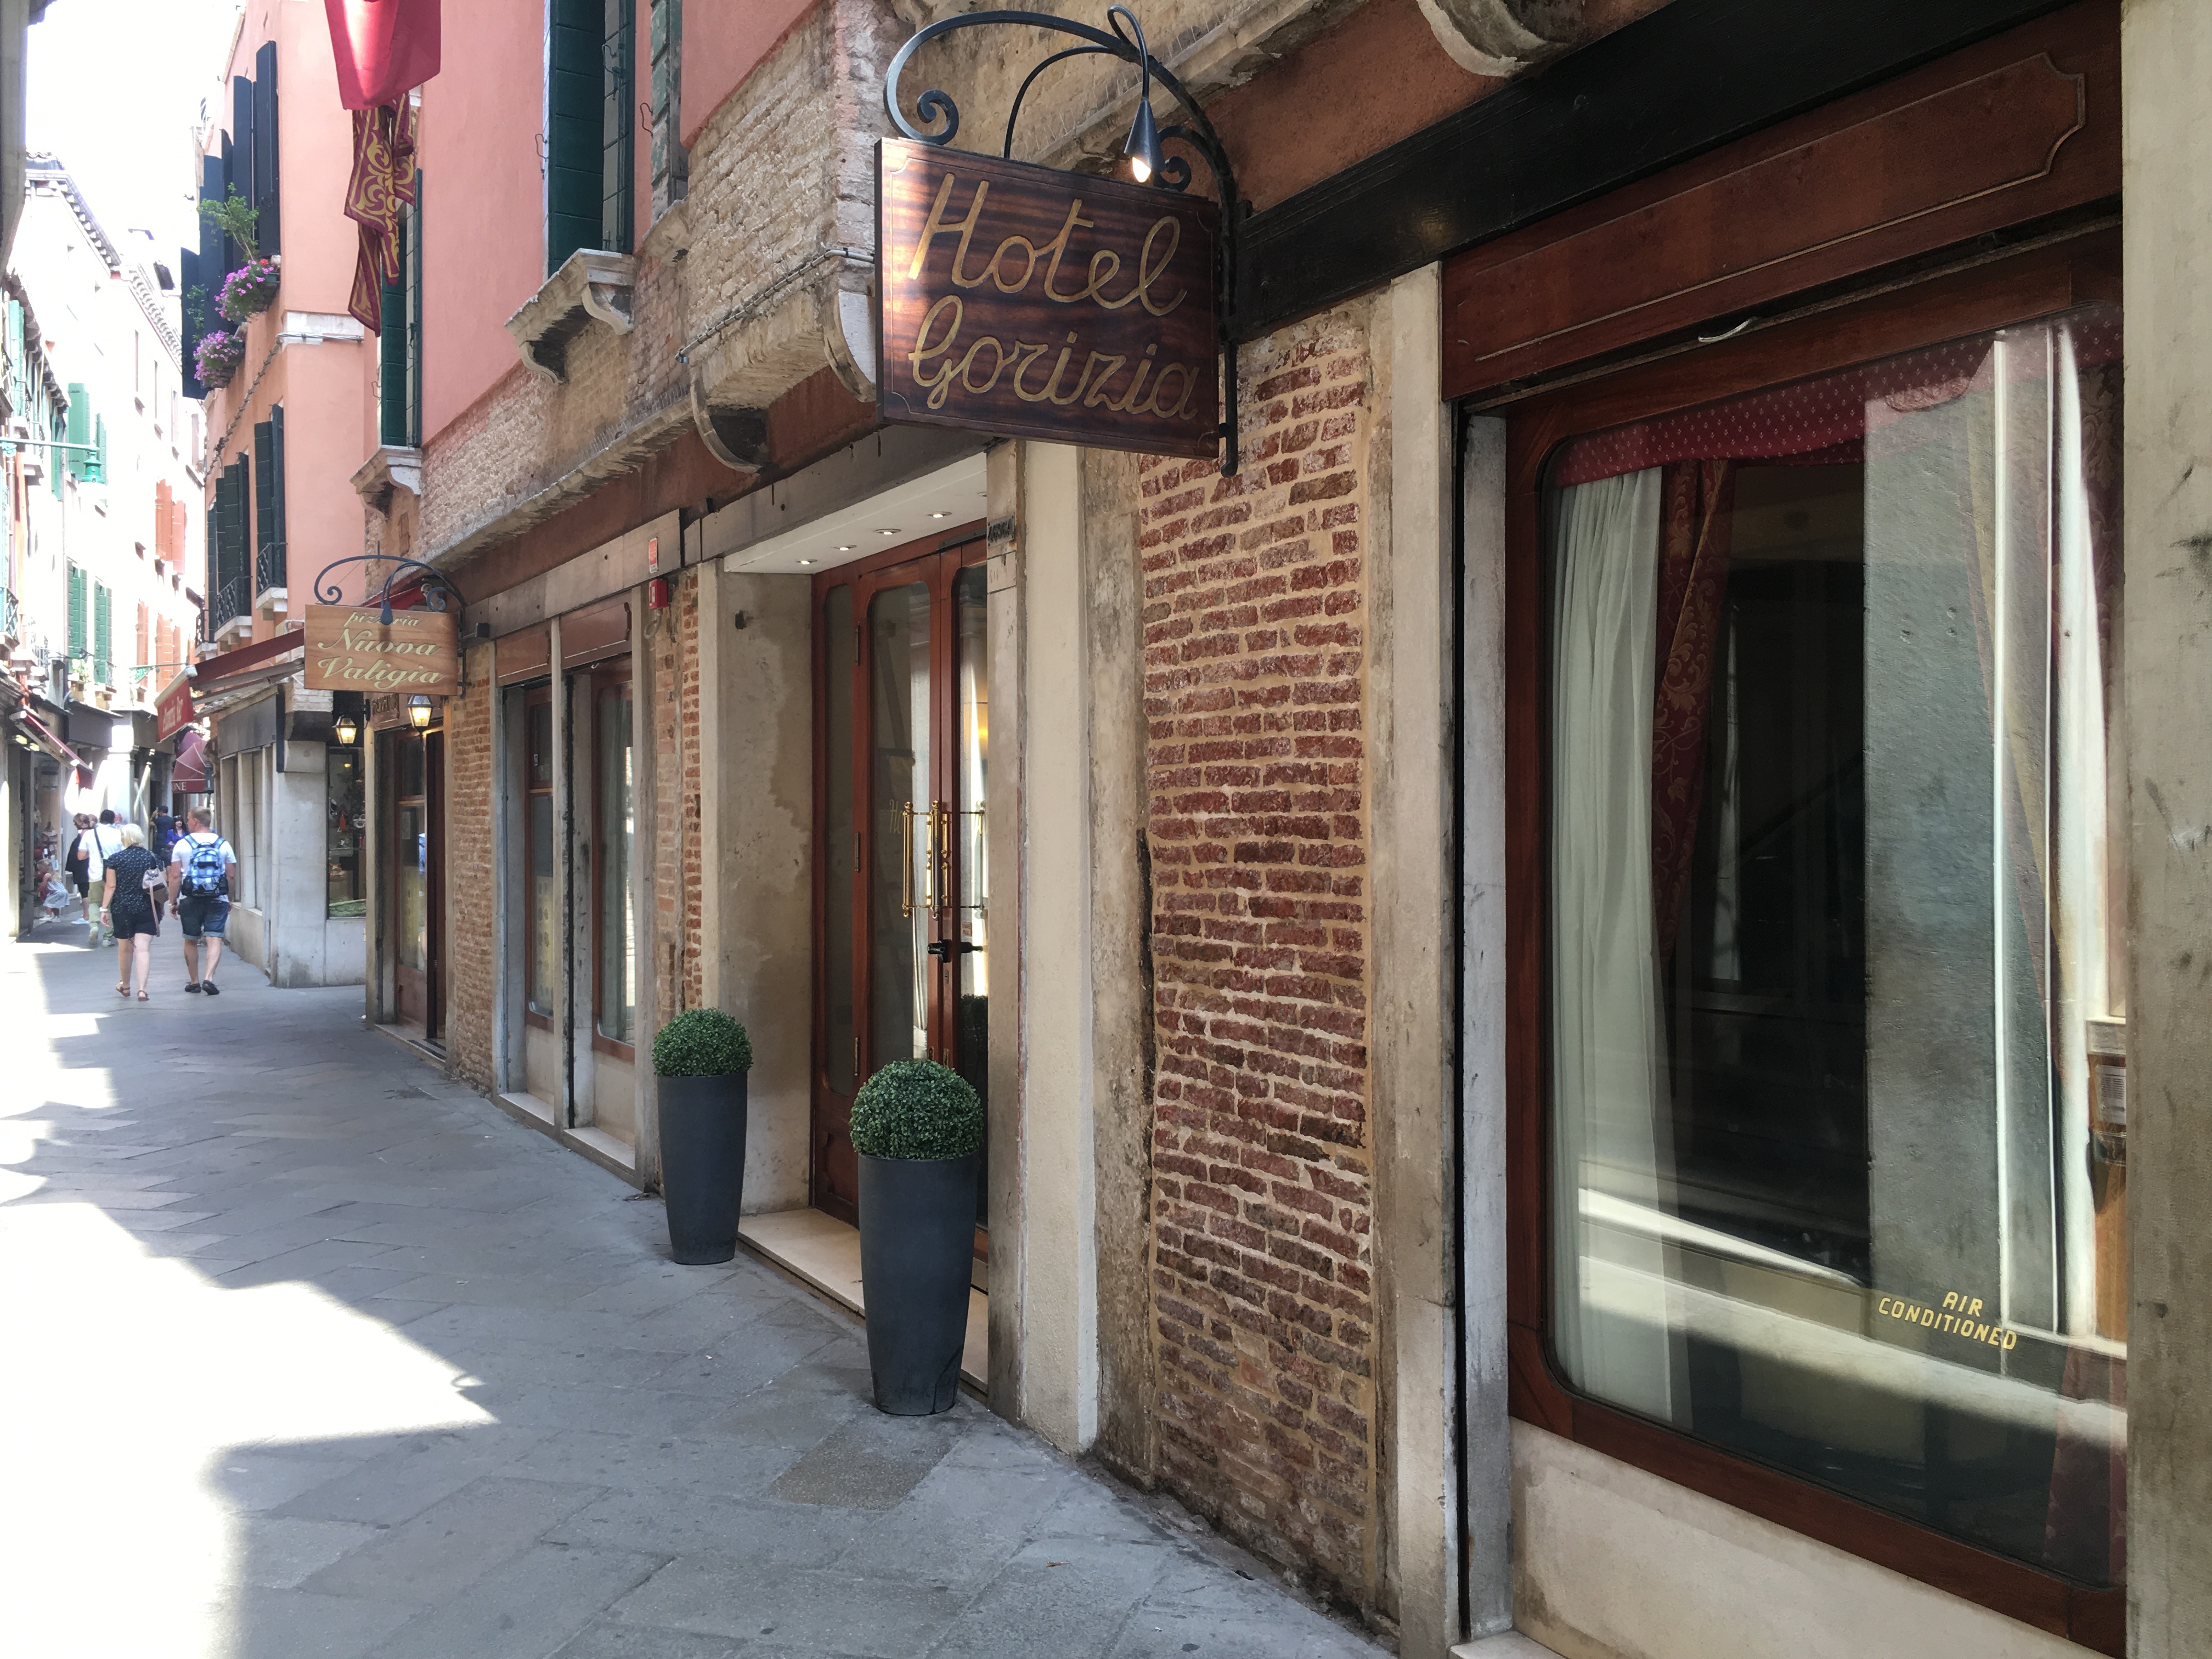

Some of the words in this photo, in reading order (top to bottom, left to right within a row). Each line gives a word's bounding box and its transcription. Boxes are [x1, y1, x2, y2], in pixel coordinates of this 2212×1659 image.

[908, 173, 1187, 316] Hotel
[908, 295, 1199, 420] Gorizia
[343, 611, 421, 627] pizzria
[318, 628, 441, 655] Nuova
[318, 656, 445, 689] Valigia
[1942, 1291, 1983, 1317] AIR
[1878, 1297, 2017, 1350] CONDITIONED
